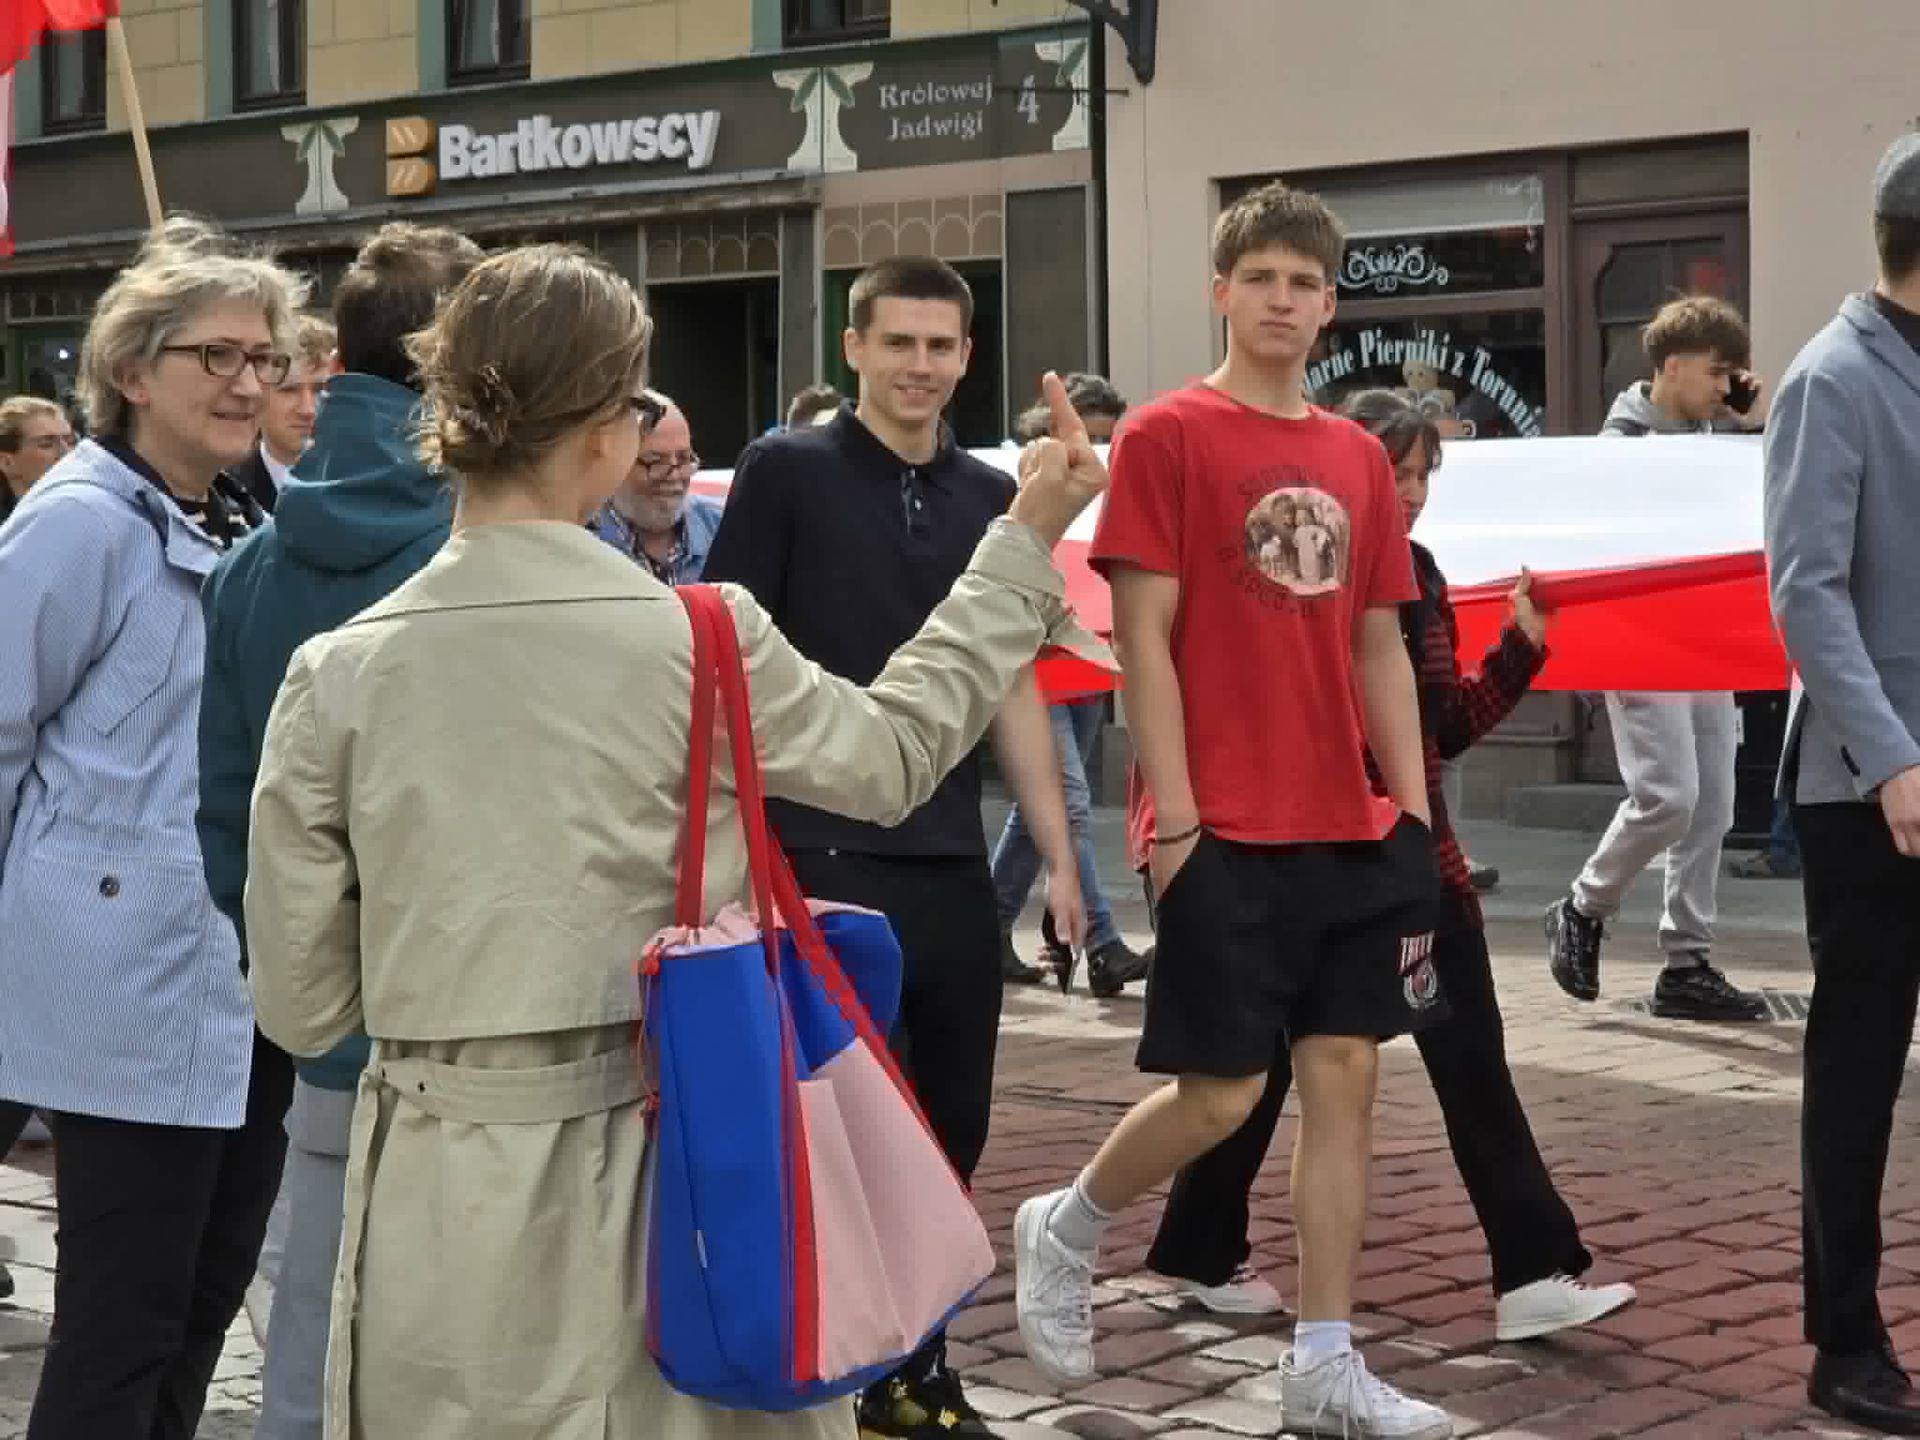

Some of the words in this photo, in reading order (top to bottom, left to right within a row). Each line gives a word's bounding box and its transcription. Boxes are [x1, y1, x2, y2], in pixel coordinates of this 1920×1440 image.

[878, 74, 993, 109] Królowej
[1017, 75, 1041, 124] 4
[438, 110, 721, 181] Bartkowscy
[887, 109, 985, 142] Jadwigi
[1358, 325, 1449, 371] Pierniki
[1451, 352, 1465, 378] z
